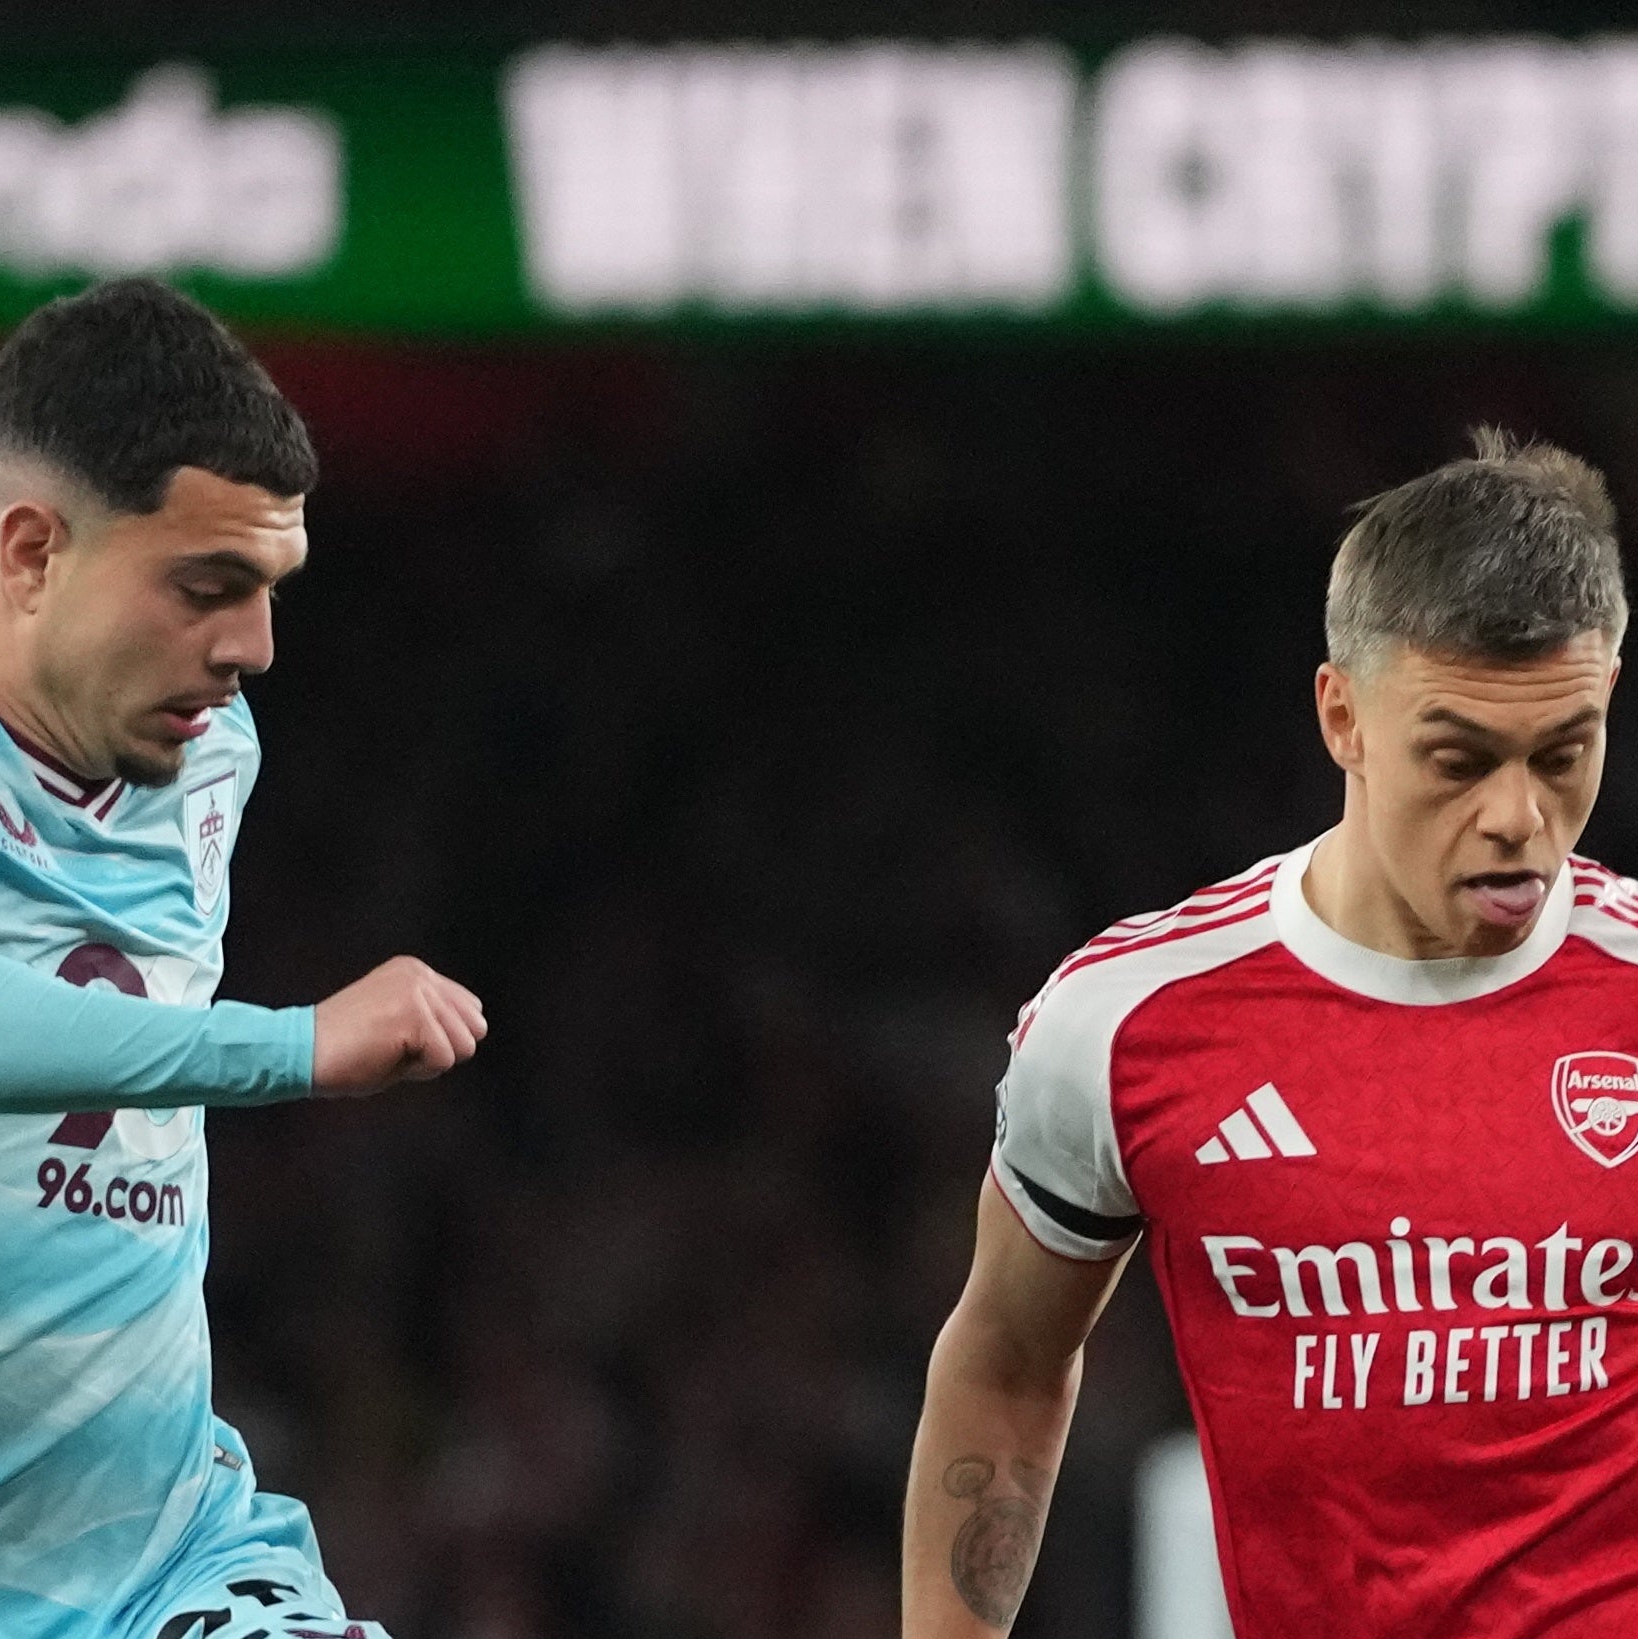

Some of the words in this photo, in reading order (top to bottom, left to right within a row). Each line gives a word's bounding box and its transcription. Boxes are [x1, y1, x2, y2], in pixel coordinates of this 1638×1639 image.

[504, 44, 1076, 312] WHEN
[37, 1157, 185, 1227] 96.com
[1293, 1332, 1381, 1409] FLY
[1402, 1316, 1610, 1406] BETTER
